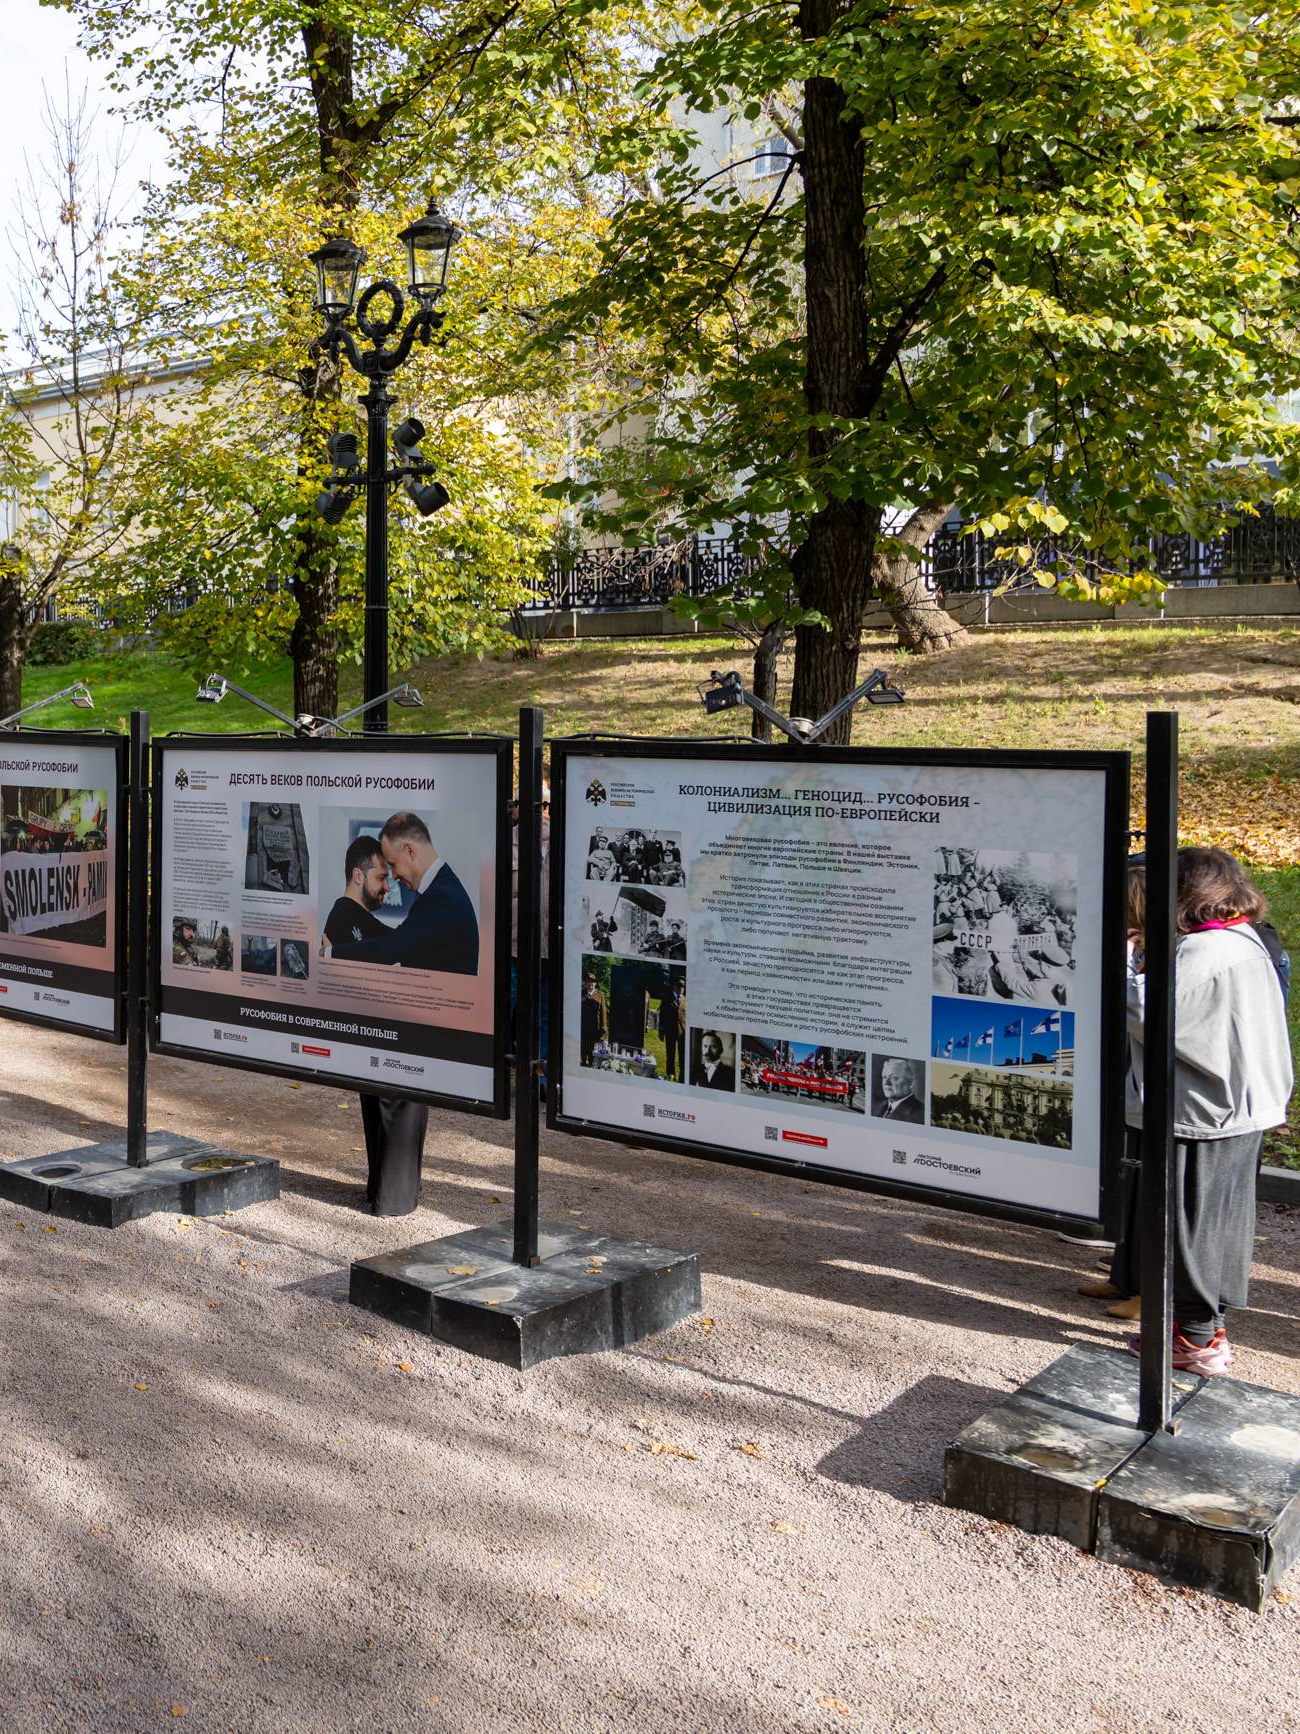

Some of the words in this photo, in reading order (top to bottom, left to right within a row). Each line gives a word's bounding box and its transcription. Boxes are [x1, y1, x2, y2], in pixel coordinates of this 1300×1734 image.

[32, 761, 77, 773] РУСОФОБИИ
[228, 773, 267, 786] ДЕСЯТЬ
[271, 774, 302, 786] ВЕКОВ
[306, 772, 361, 788] ПОЛЬСКОЙ
[365, 775, 435, 790] РУСОФОБИИ
[678, 784, 790, 800] КОЛОНИАЛИЗМ...
[794, 789, 873, 806] ГЕНОЦИД...
[876, 792, 969, 808] РУСОФОБИЯ
[707, 801, 811, 818] ЦИВИЛИЗАЦИЯ
[815, 805, 940, 824] ПО-ЕВРОПЕЙСКИ
[4, 852, 80, 922] SMOLEŃSK
[960, 932, 991, 949] СССР
[27, 966, 52, 978] ПОЛЬШЕ
[239, 1006, 287, 1022] РУСОФОБИЯ
[288, 1014, 293, 1024] В
[294, 1014, 358, 1034] СОВРЕМЕННОЙ
[360, 1025, 398, 1041] ПОЛЬШЕ
